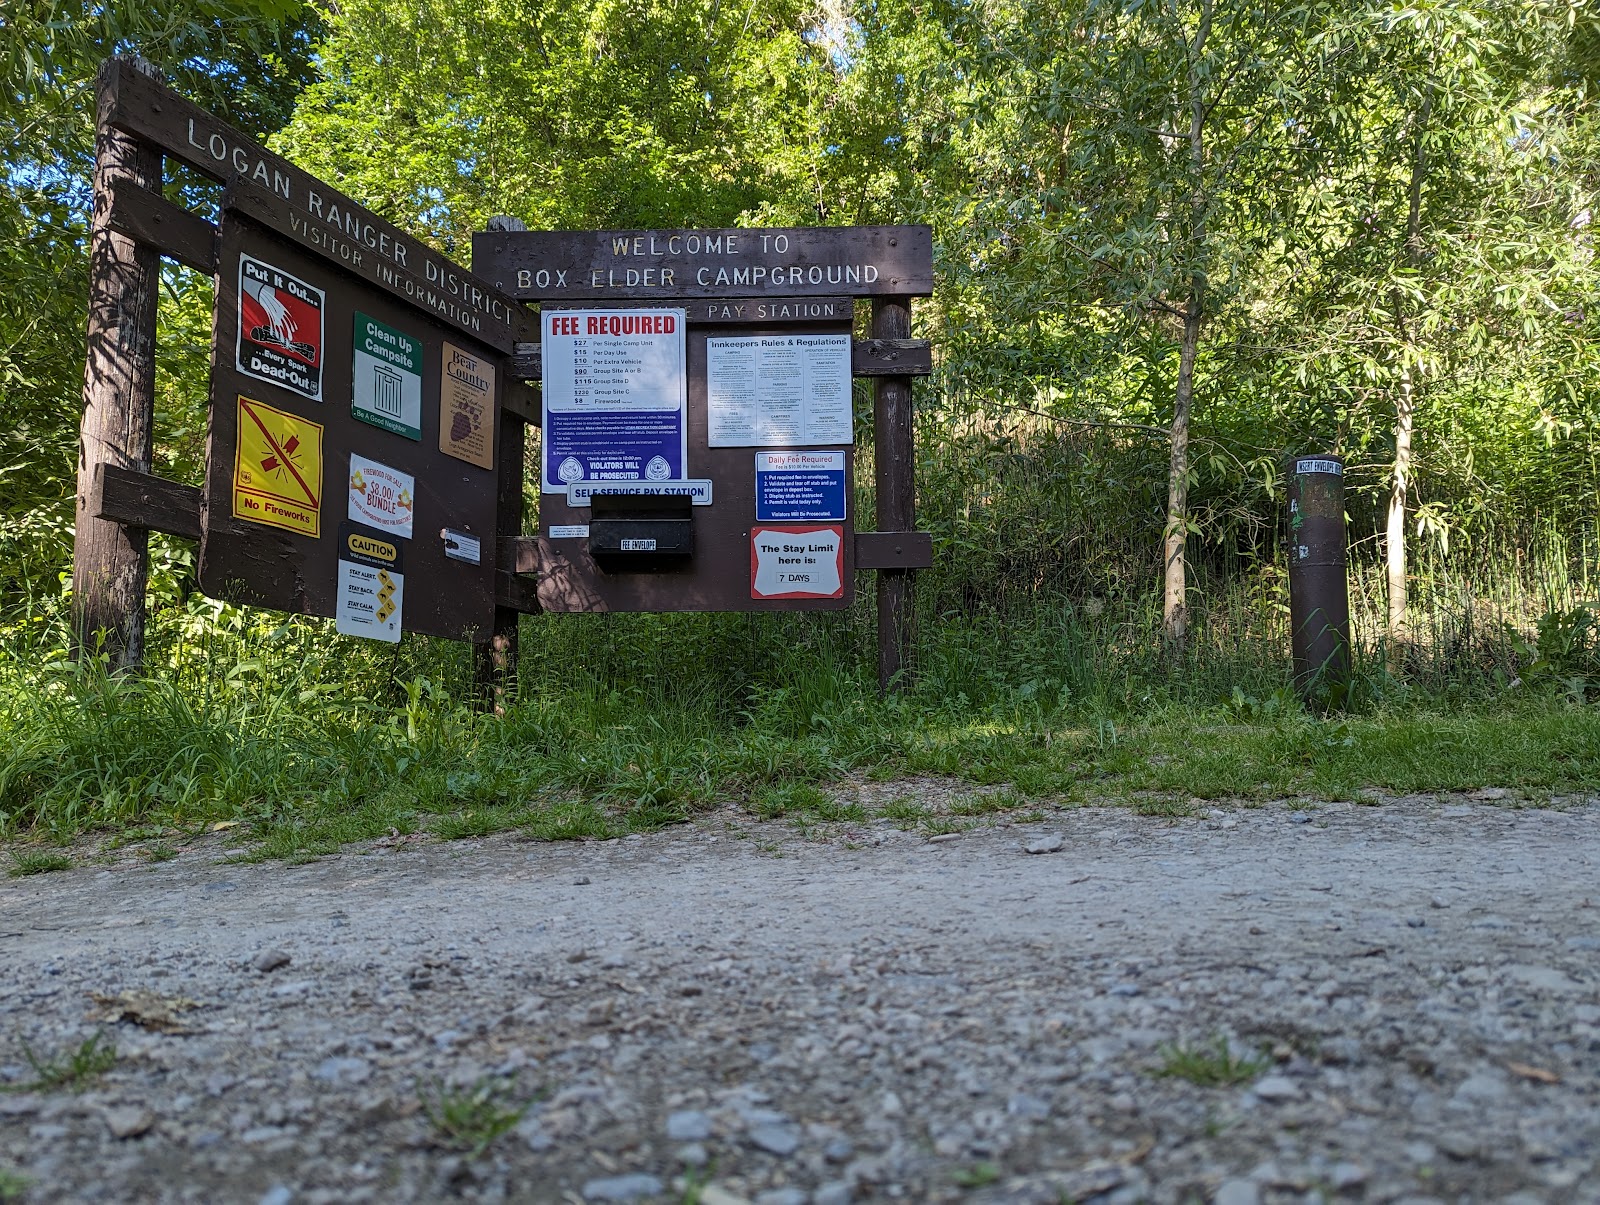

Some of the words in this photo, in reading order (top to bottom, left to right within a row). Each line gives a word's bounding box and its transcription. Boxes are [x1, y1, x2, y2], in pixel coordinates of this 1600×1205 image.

[188, 117, 290, 199] LOGAN
[310, 192, 407, 267] RANGER
[426, 258, 513, 325] DISTRICT
[613, 235, 739, 256] WELCOME
[760, 234, 789, 254] TO
[246, 262, 268, 282] Put
[274, 274, 283, 288] It
[289, 213, 363, 268] VISITOR
[376, 263, 481, 333] INFORMATION
[518, 268, 567, 289] BOX
[592, 268, 675, 288] ELDER
[697, 265, 879, 286] CAMPGROUND
[709, 305, 747, 318] PAY
[758, 303, 836, 317] STATION
[552, 317, 579, 335] FEE
[588, 316, 675, 336] REQUIRED
[367, 323, 396, 345] Clean
[399, 337, 412, 353] Up
[796, 338, 846, 347] Regulations
[366, 338, 413, 368] Campsite
[453, 350, 477, 372] Bear
[251, 357, 309, 389] Dead-Out
[288, 359, 307, 373] Spark
[447, 362, 490, 396] Country
[357, 410, 364, 418] Be
[365, 412, 369, 420] A
[370, 415, 384, 425] Good
[385, 419, 406, 433] Neighbor
[802, 456, 832, 464] Required
[1299, 462, 1313, 471] INSERT
[1315, 461, 1334, 472] ENVELOPE
[664, 488, 704, 496] STATION
[245, 498, 259, 509] No
[265, 503, 310, 523] Fireworks
[367, 493, 396, 515] BUNDLE
[352, 539, 393, 557] CAUTION
[622, 541, 630, 549] FEE
[632, 540, 656, 550] ENVELOPE
[783, 545, 805, 553] Stay
[361, 572, 376, 580] ALERT.
